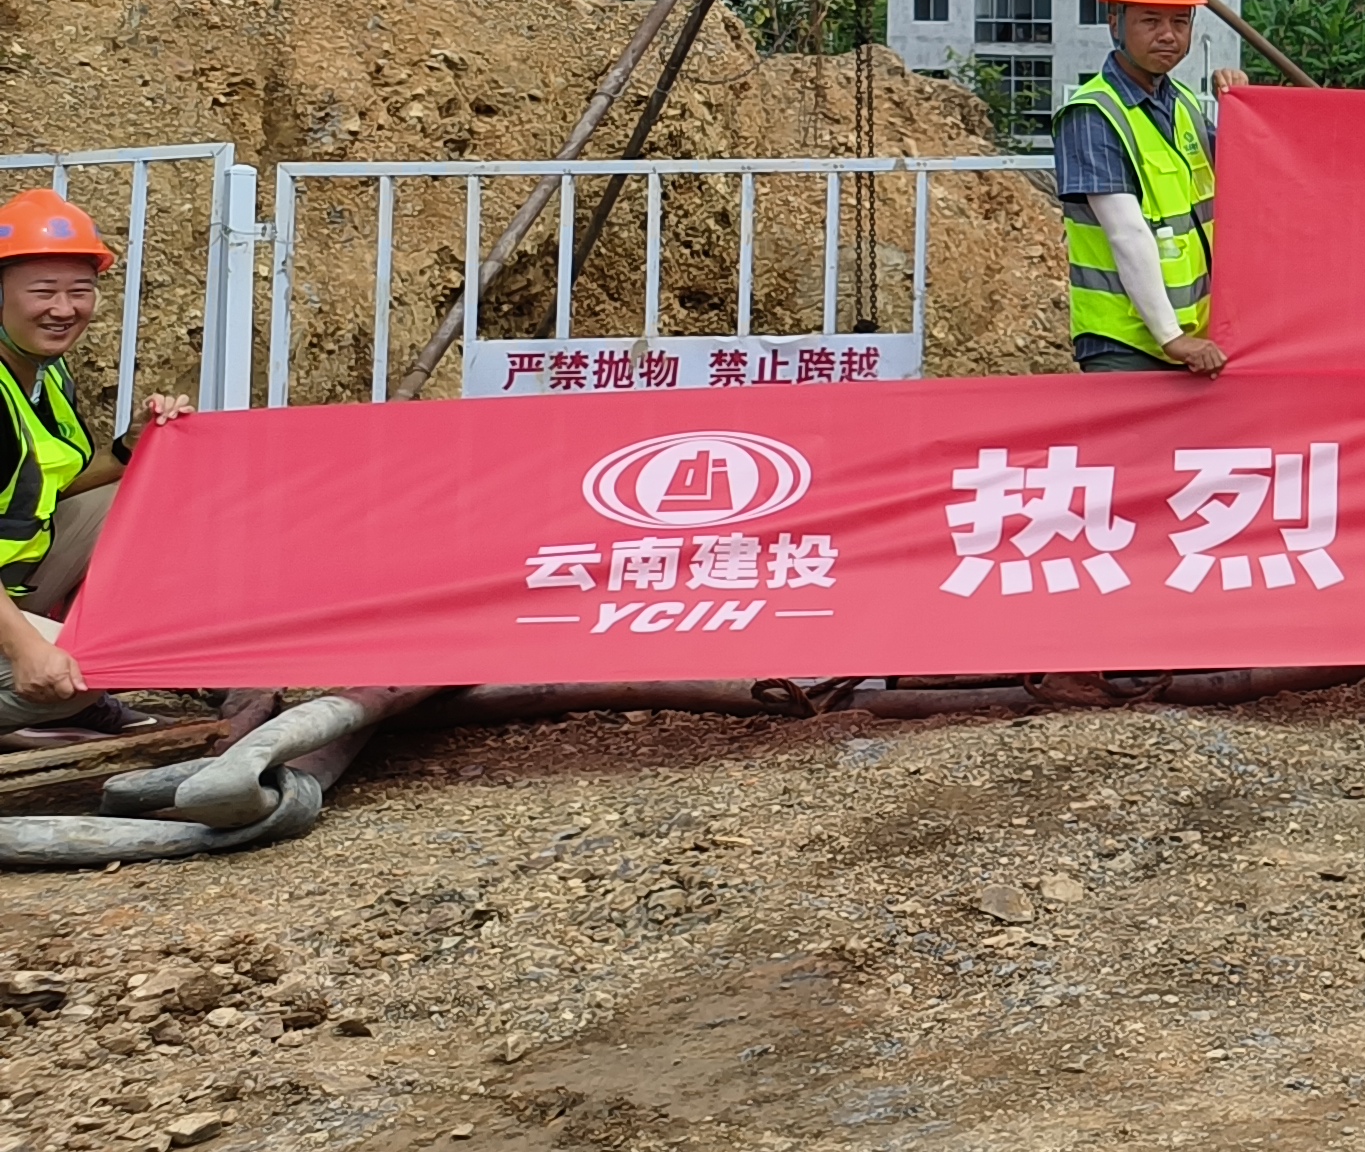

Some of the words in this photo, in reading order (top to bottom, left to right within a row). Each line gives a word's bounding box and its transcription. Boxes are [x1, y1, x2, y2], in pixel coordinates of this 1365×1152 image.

[502, 349, 680, 391] 严禁抛物
[709, 346, 881, 388] 禁止跨越
[525, 532, 839, 592] 云南建投
[589, 599, 768, 635] YCIH
